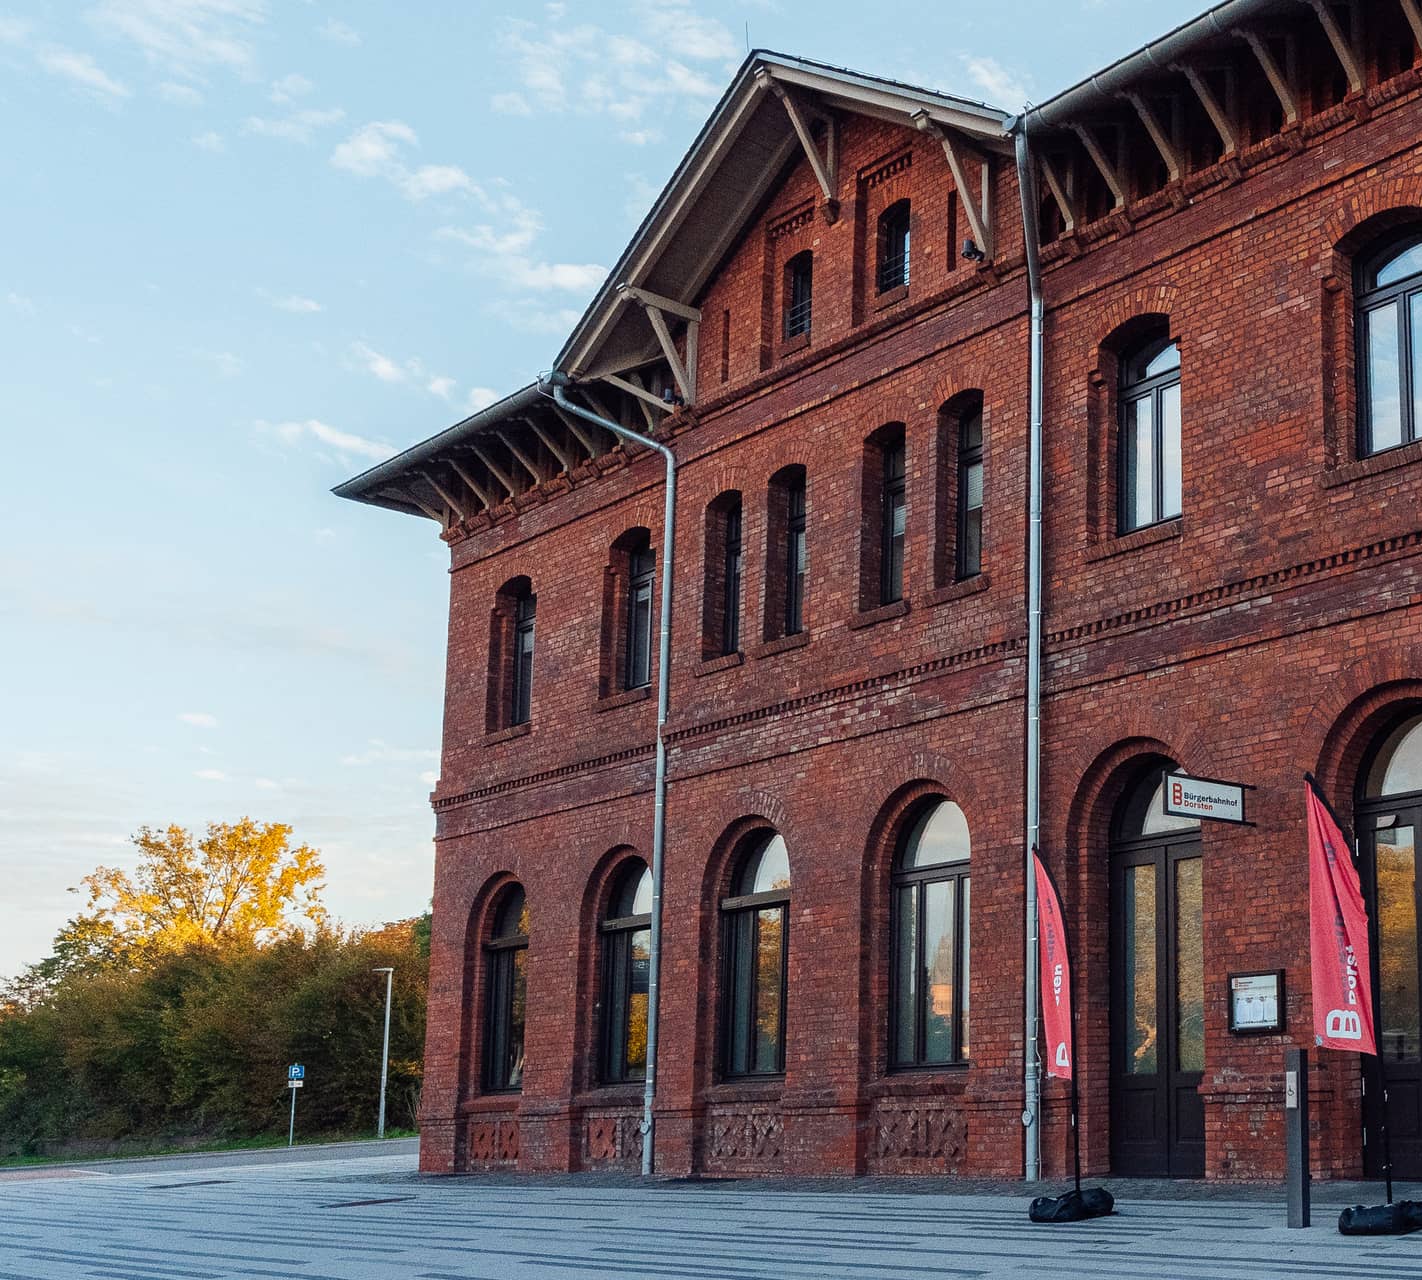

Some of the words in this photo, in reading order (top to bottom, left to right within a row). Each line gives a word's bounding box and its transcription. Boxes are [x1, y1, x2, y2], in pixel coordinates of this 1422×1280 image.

[1184, 792, 1237, 806] Bürgerbahnhof
[1184, 801, 1213, 810] Dorsten
[1326, 1009, 1361, 1039] B
[291, 1067, 300, 1077] P
